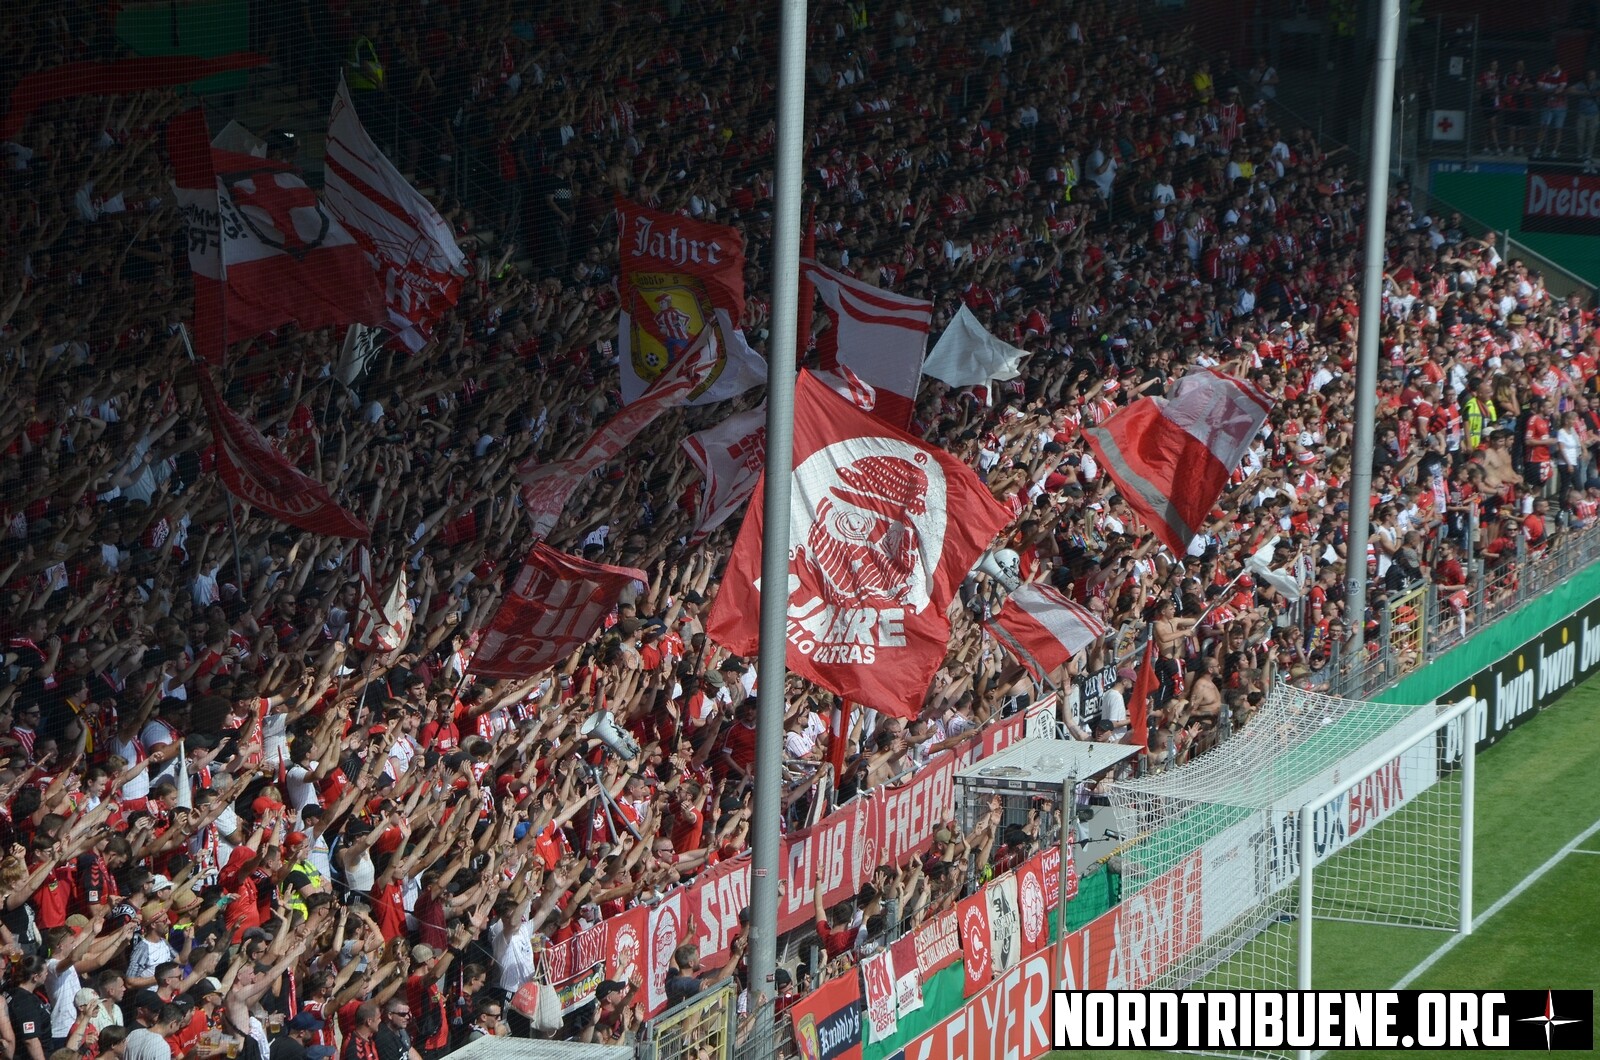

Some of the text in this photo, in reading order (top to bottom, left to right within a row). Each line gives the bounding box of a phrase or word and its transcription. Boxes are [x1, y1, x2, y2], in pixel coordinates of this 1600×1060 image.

[632, 214, 722, 267] Jahre
[813, 645, 876, 664] ULTRAS
[1538, 626, 1576, 701] bwin
[1495, 654, 1534, 731] bwin
[787, 820, 846, 914] CLUB
[1043, 848, 1072, 873] KHAD
